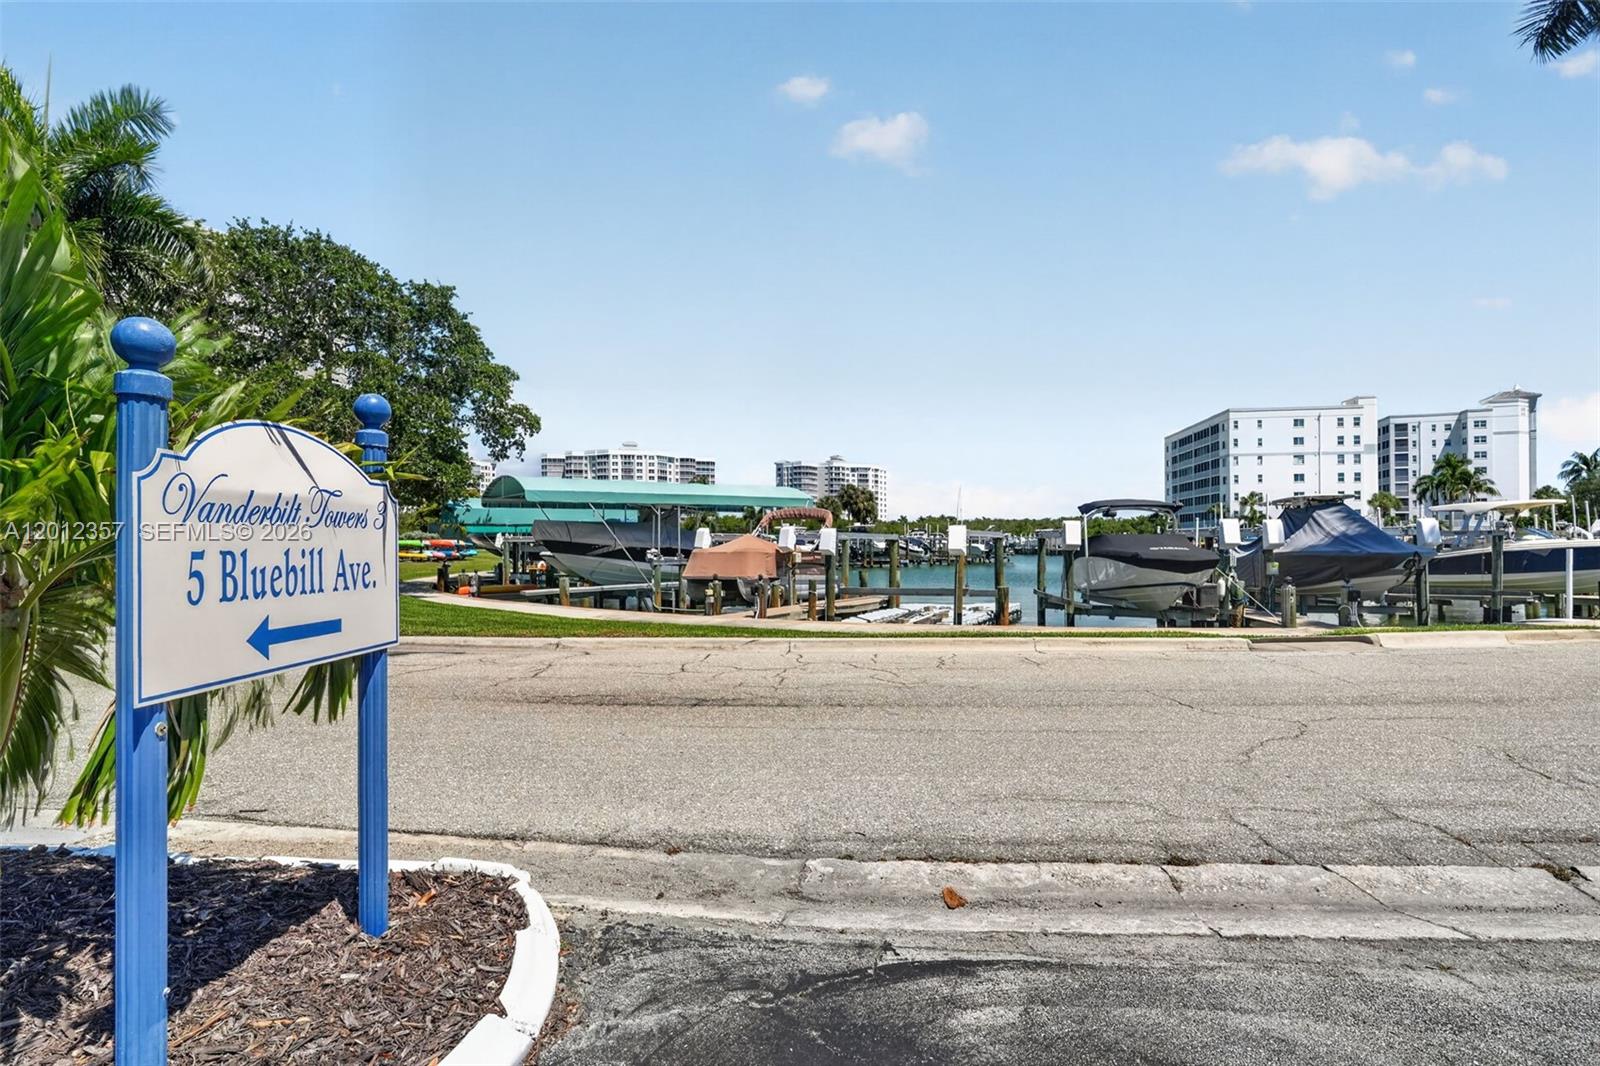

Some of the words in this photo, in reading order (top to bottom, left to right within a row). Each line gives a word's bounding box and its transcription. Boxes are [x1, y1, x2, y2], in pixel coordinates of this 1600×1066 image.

[162, 472, 302, 528] Vanderbilt
[304, 486, 369, 529] Towers
[376, 500, 387, 530] 3
[187, 549, 206, 606] 5
[218, 548, 325, 603] Bluebill
[332, 549, 377, 592] Ave.
